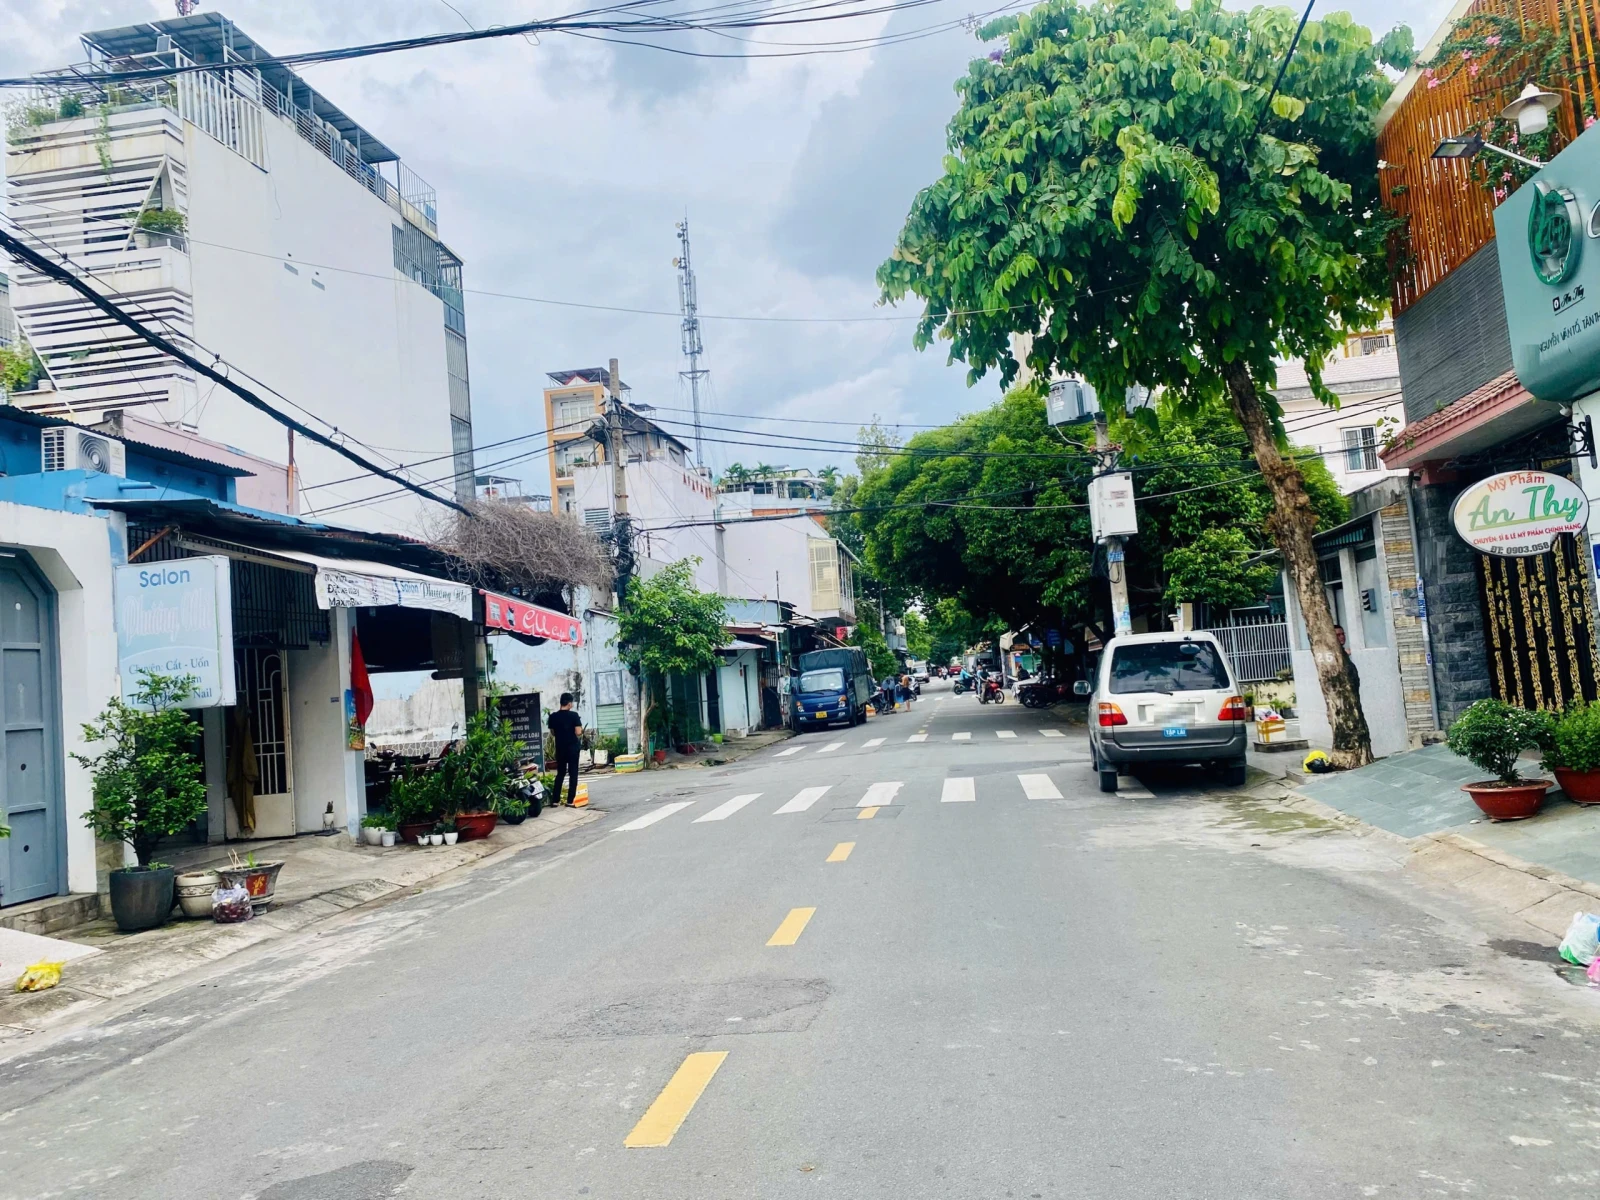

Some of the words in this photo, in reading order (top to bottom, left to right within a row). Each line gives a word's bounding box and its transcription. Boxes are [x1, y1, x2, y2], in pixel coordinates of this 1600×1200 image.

[1487, 478, 1507, 492] Mỹ
[1510, 472, 1545, 486] Phẩm
[1468, 494, 1515, 530] An
[1522, 484, 1583, 522] Thy
[1505, 533, 1510, 541] &
[1506, 541, 1550, 555] 0903.058
[140, 568, 191, 588] Salon
[401, 582, 419, 594] Salon
[165, 657, 182, 671] Cắt
[190, 656, 210, 669] Uốn
[193, 688, 212, 699] Nail
